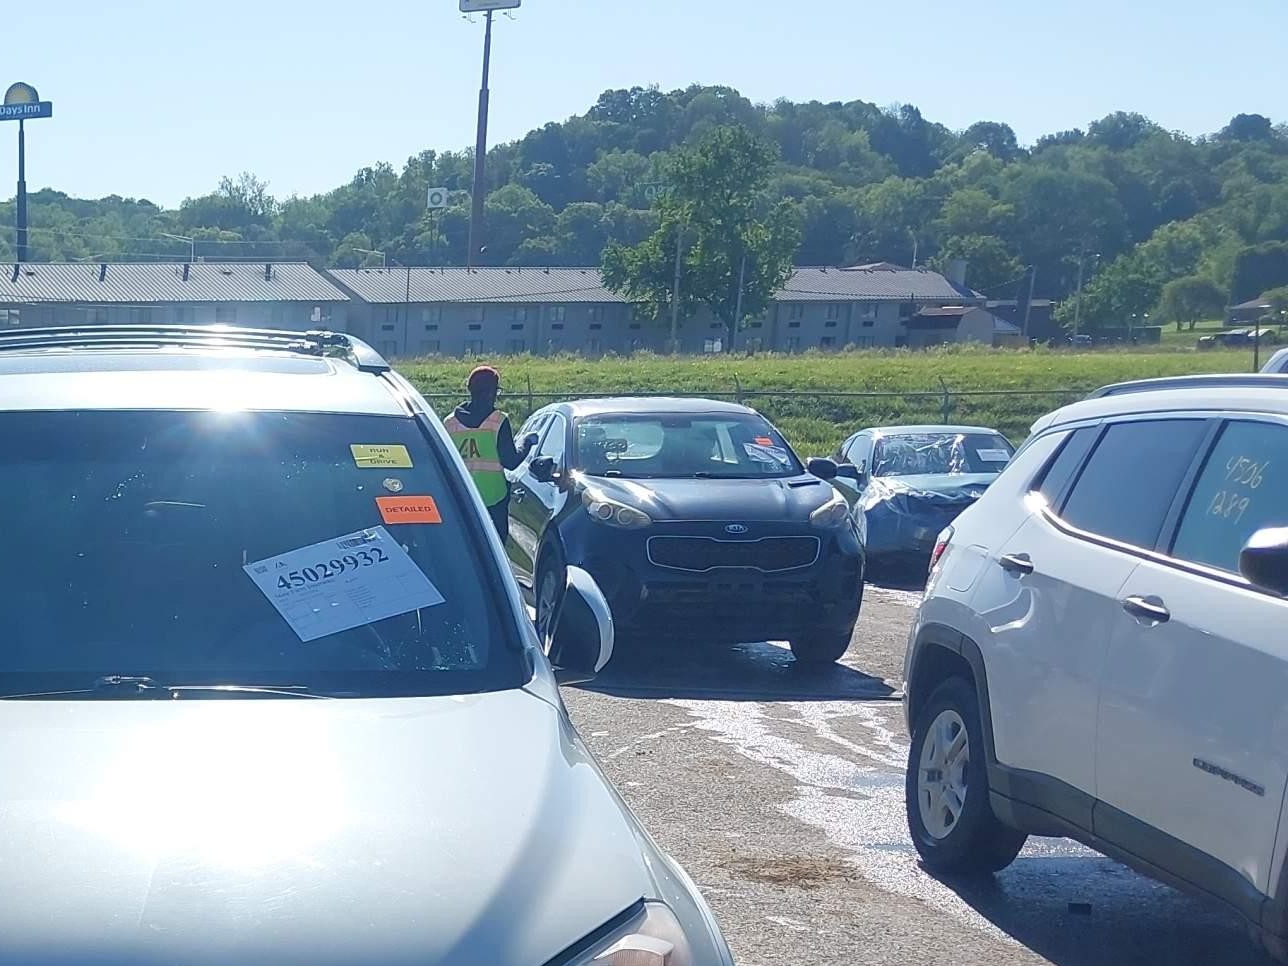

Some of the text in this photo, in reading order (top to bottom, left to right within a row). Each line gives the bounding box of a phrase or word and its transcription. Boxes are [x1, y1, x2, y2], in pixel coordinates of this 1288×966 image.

[23, 104, 41, 113] Inn
[385, 505, 432, 513] DETAILED
[276, 547, 390, 591] 45029932
